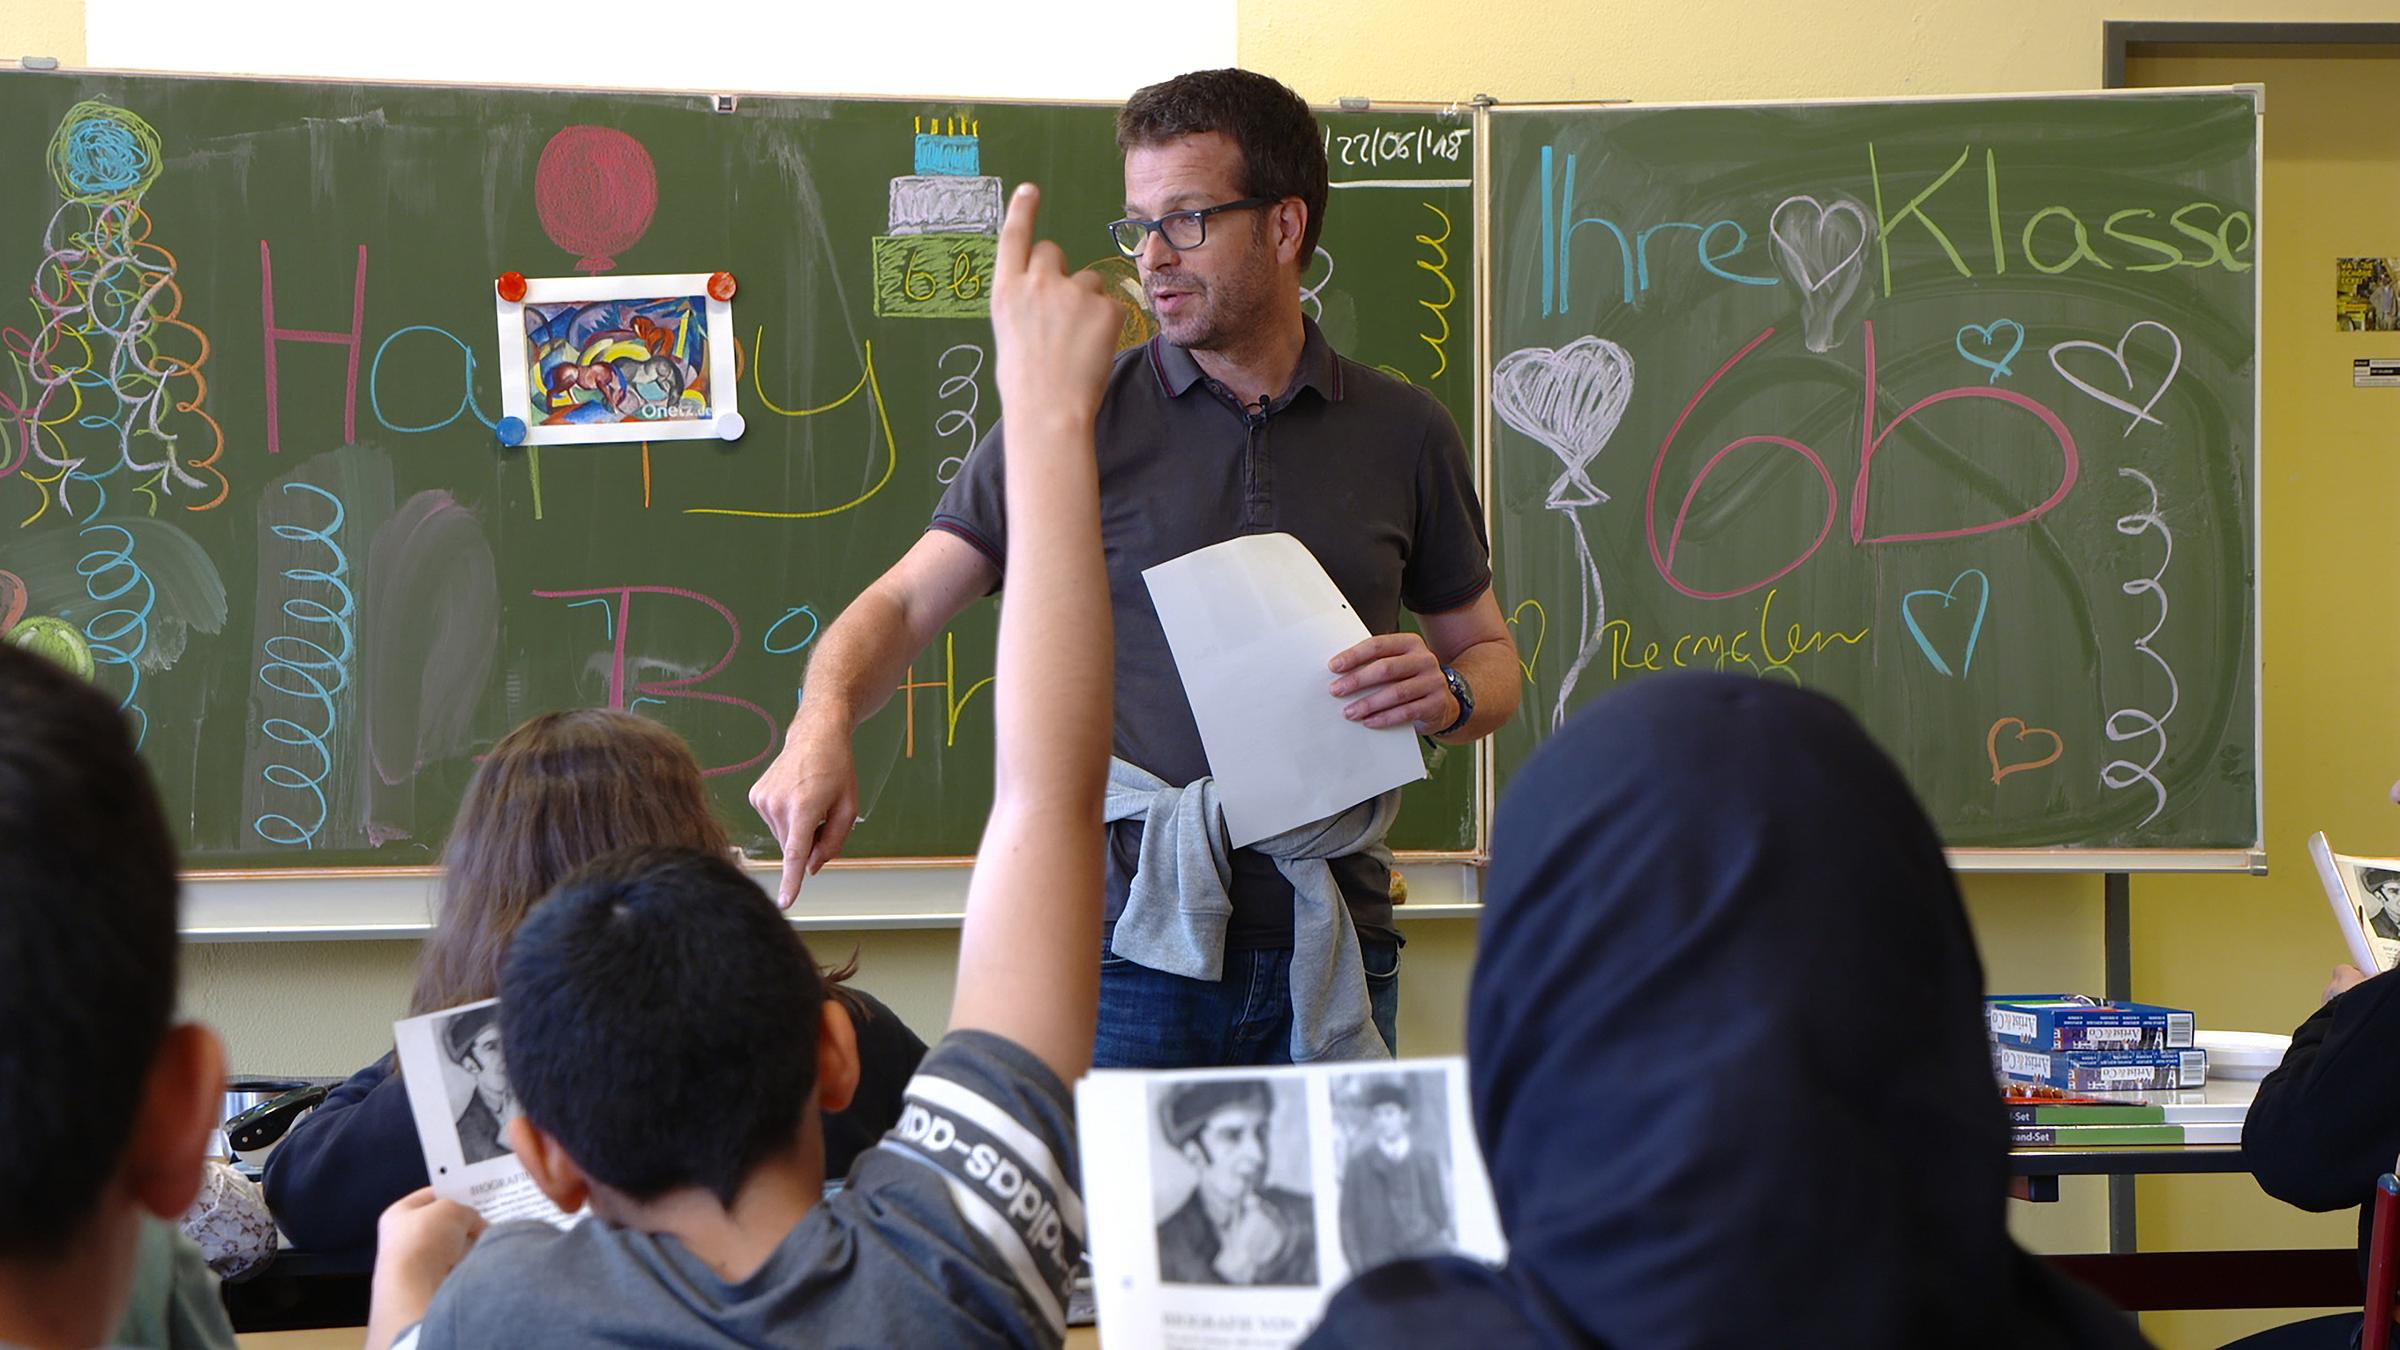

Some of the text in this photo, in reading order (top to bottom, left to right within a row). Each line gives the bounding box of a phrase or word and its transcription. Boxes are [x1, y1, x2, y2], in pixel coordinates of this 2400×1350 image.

[1541, 141, 2251, 319] Ihre Klasse
[1646, 320, 2079, 600] 6b
